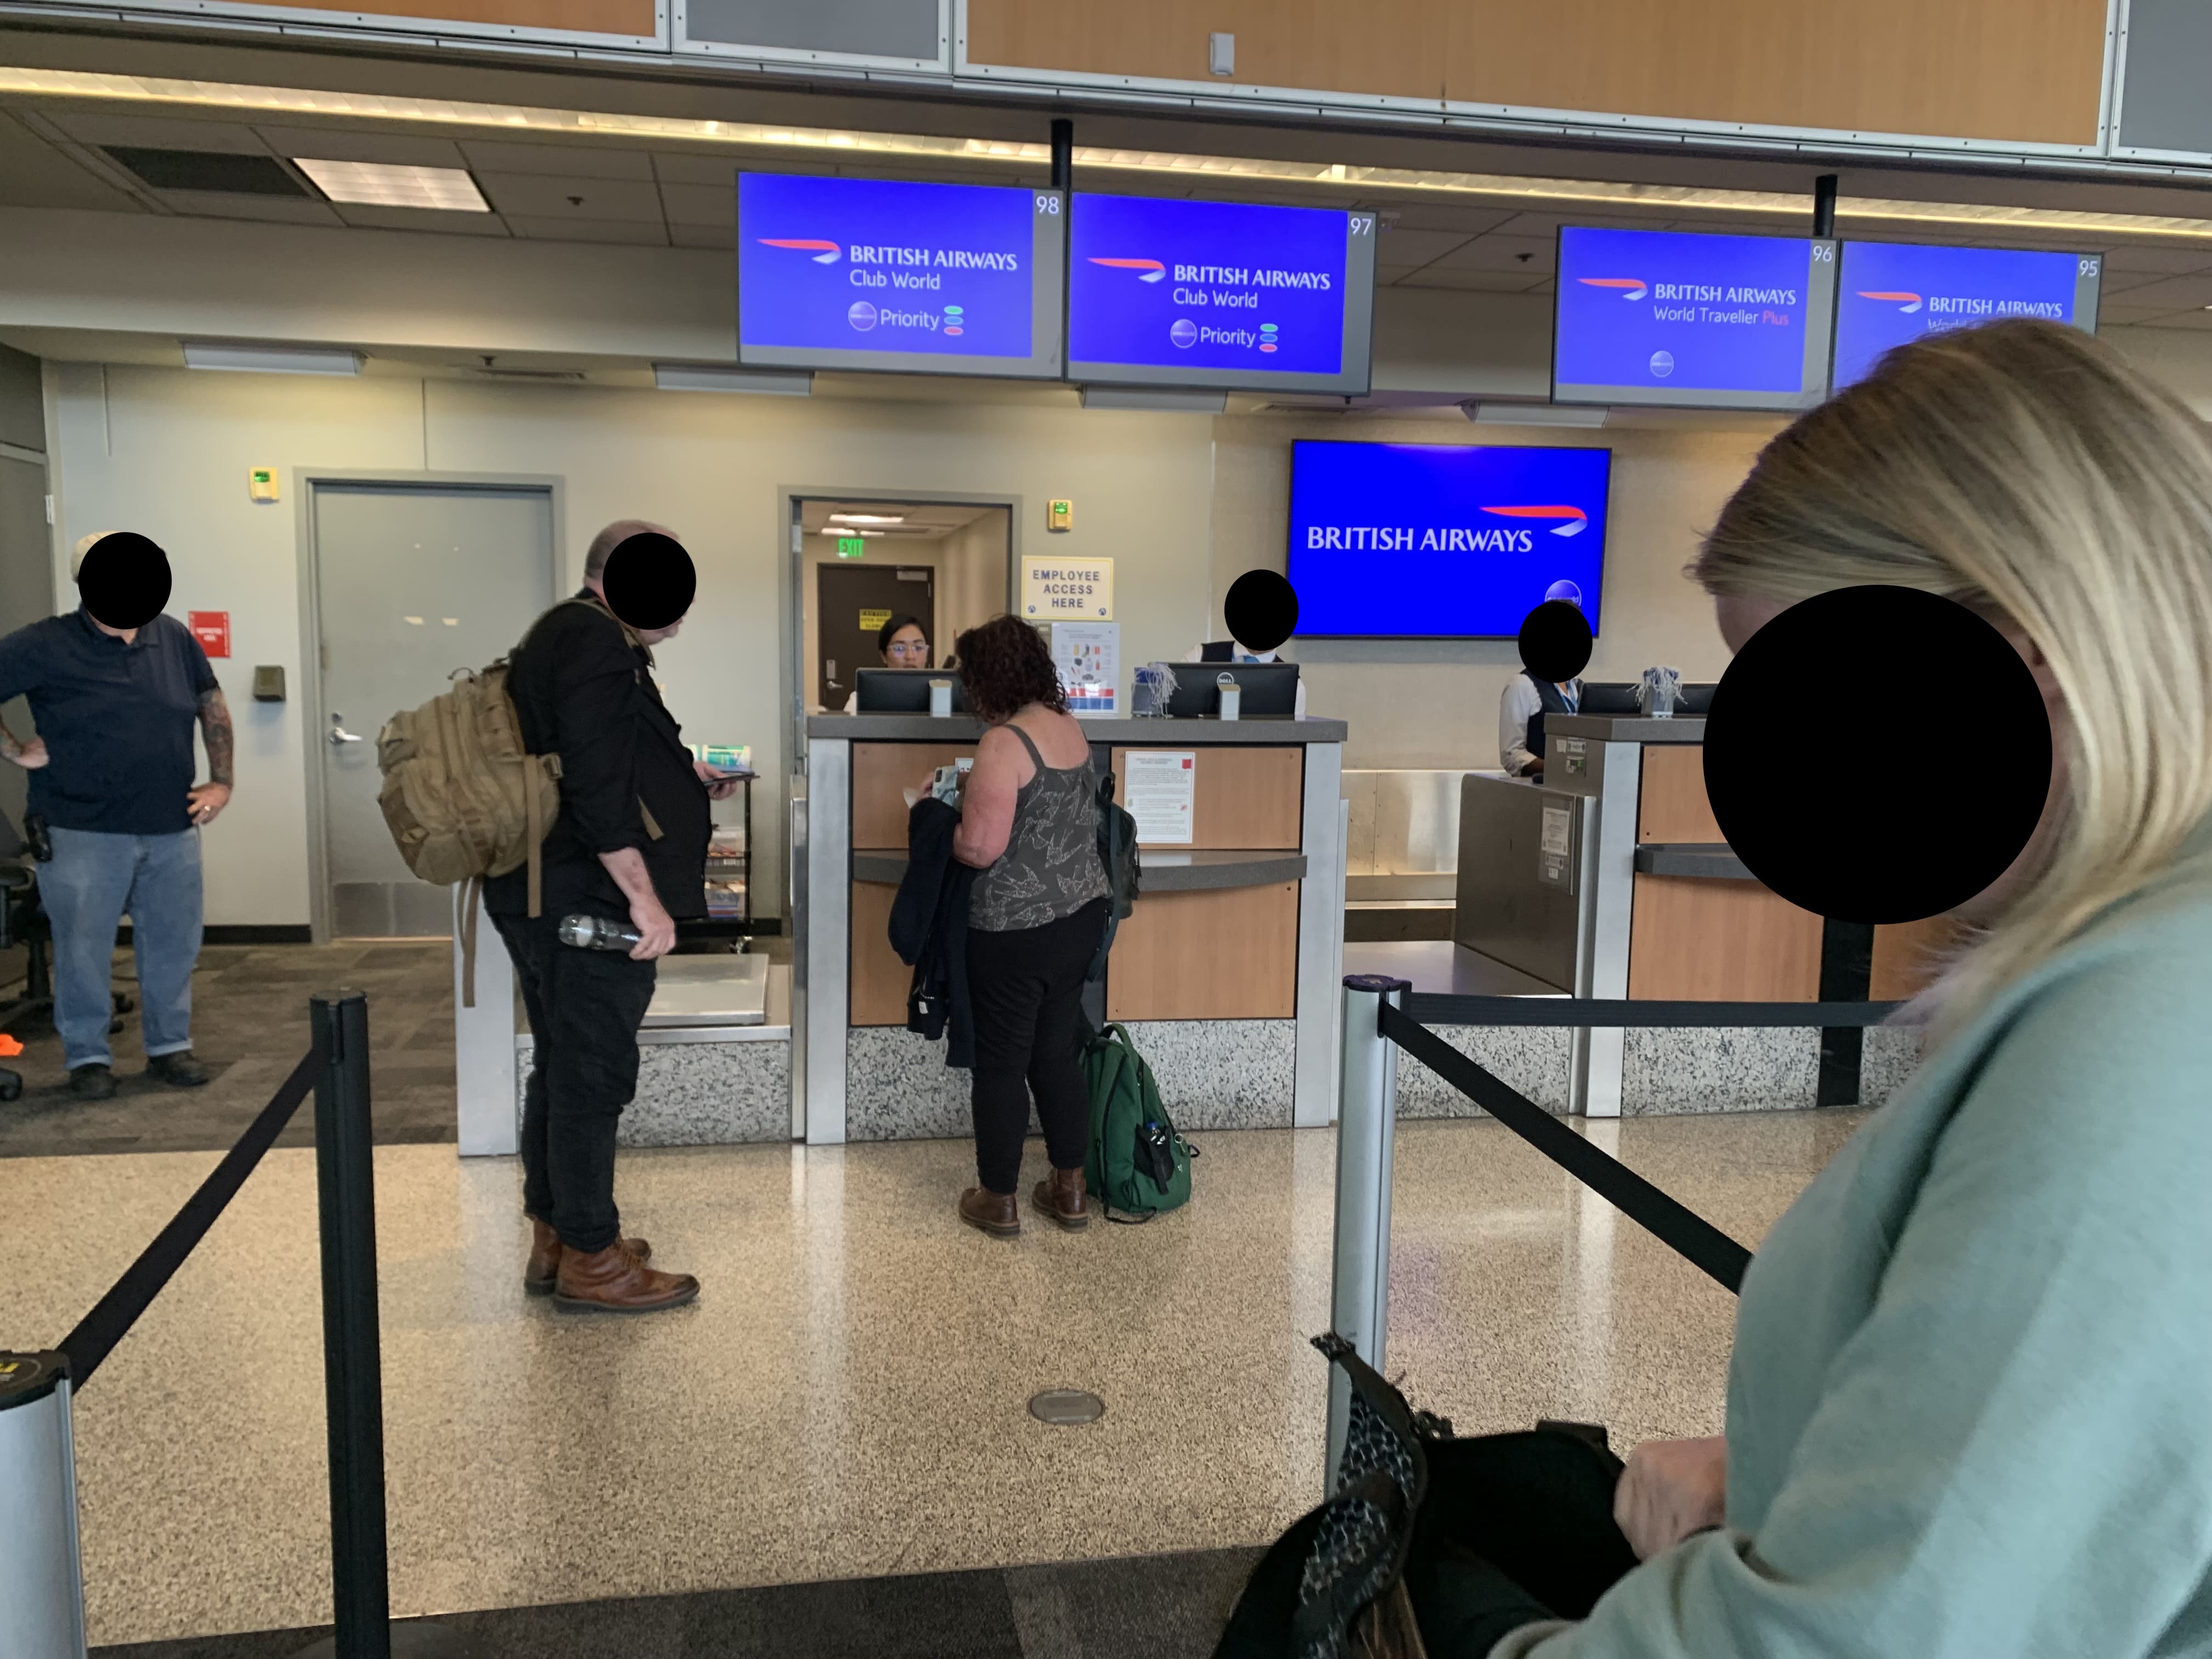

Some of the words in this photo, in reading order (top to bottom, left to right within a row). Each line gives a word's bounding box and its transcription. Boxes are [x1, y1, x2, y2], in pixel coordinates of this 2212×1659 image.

[1036, 196, 1059, 215] 98
[1350, 217, 1372, 235] 97
[850, 245, 929, 267] BRITISH
[934, 250, 1018, 271] AIRWAYS
[1813, 245, 1832, 262] 96
[1174, 264, 1248, 285] BRITISH
[1252, 269, 1331, 290] AIRWAYS
[2079, 259, 2098, 278] 95
[849, 269, 888, 287] Club
[891, 271, 941, 290] World
[1173, 287, 1208, 306] Club
[1212, 290, 1258, 308] World
[1655, 283, 1722, 302] BRITISH
[1725, 287, 1796, 306] AIRWAYS
[1654, 305, 1695, 322] World
[1700, 307, 1759, 325] Traveller
[1762, 309, 1789, 326] Plus
[1929, 297, 1993, 314] BRITISH
[1996, 300, 2063, 318] AIRWAYS
[881, 309, 940, 331] Priority
[1200, 326, 1256, 348] Priority
[838, 538, 864, 557] EXIT
[1307, 526, 1414, 550] BRITISH
[1419, 528, 1533, 552] AIRWAYS
[1033, 569, 1099, 582] EMPLOYEE
[1043, 584, 1092, 595] ACCESS
[1052, 597, 1084, 608] HERE
